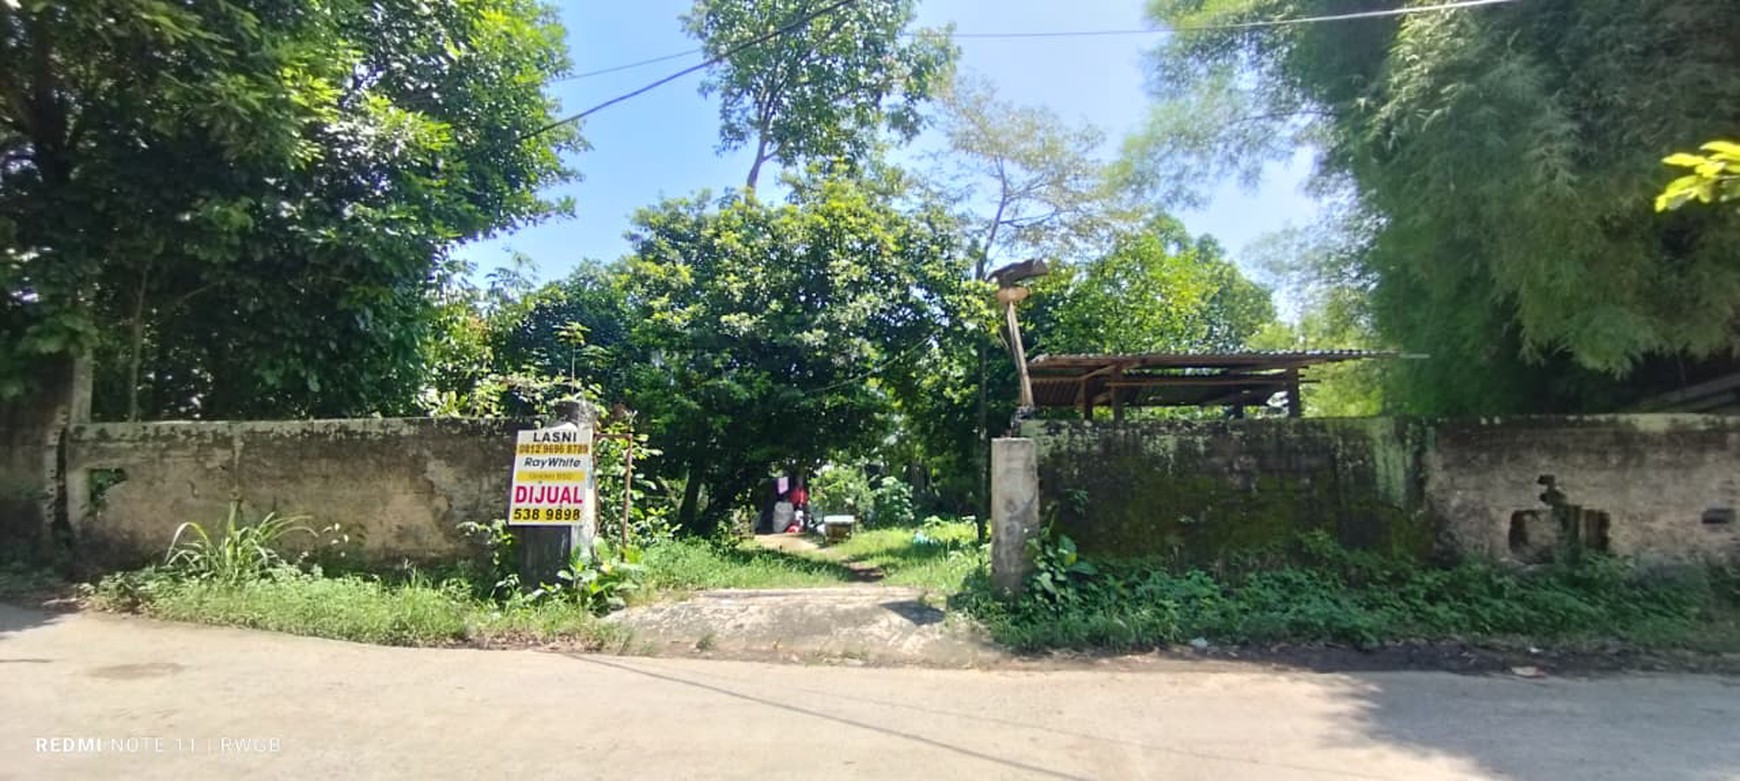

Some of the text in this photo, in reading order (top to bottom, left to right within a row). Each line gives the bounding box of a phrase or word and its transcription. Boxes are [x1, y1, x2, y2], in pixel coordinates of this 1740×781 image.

[533, 432, 577, 442] LASNI
[515, 485, 583, 504] DIJUAL
[513, 508, 580, 520] 538 9898
